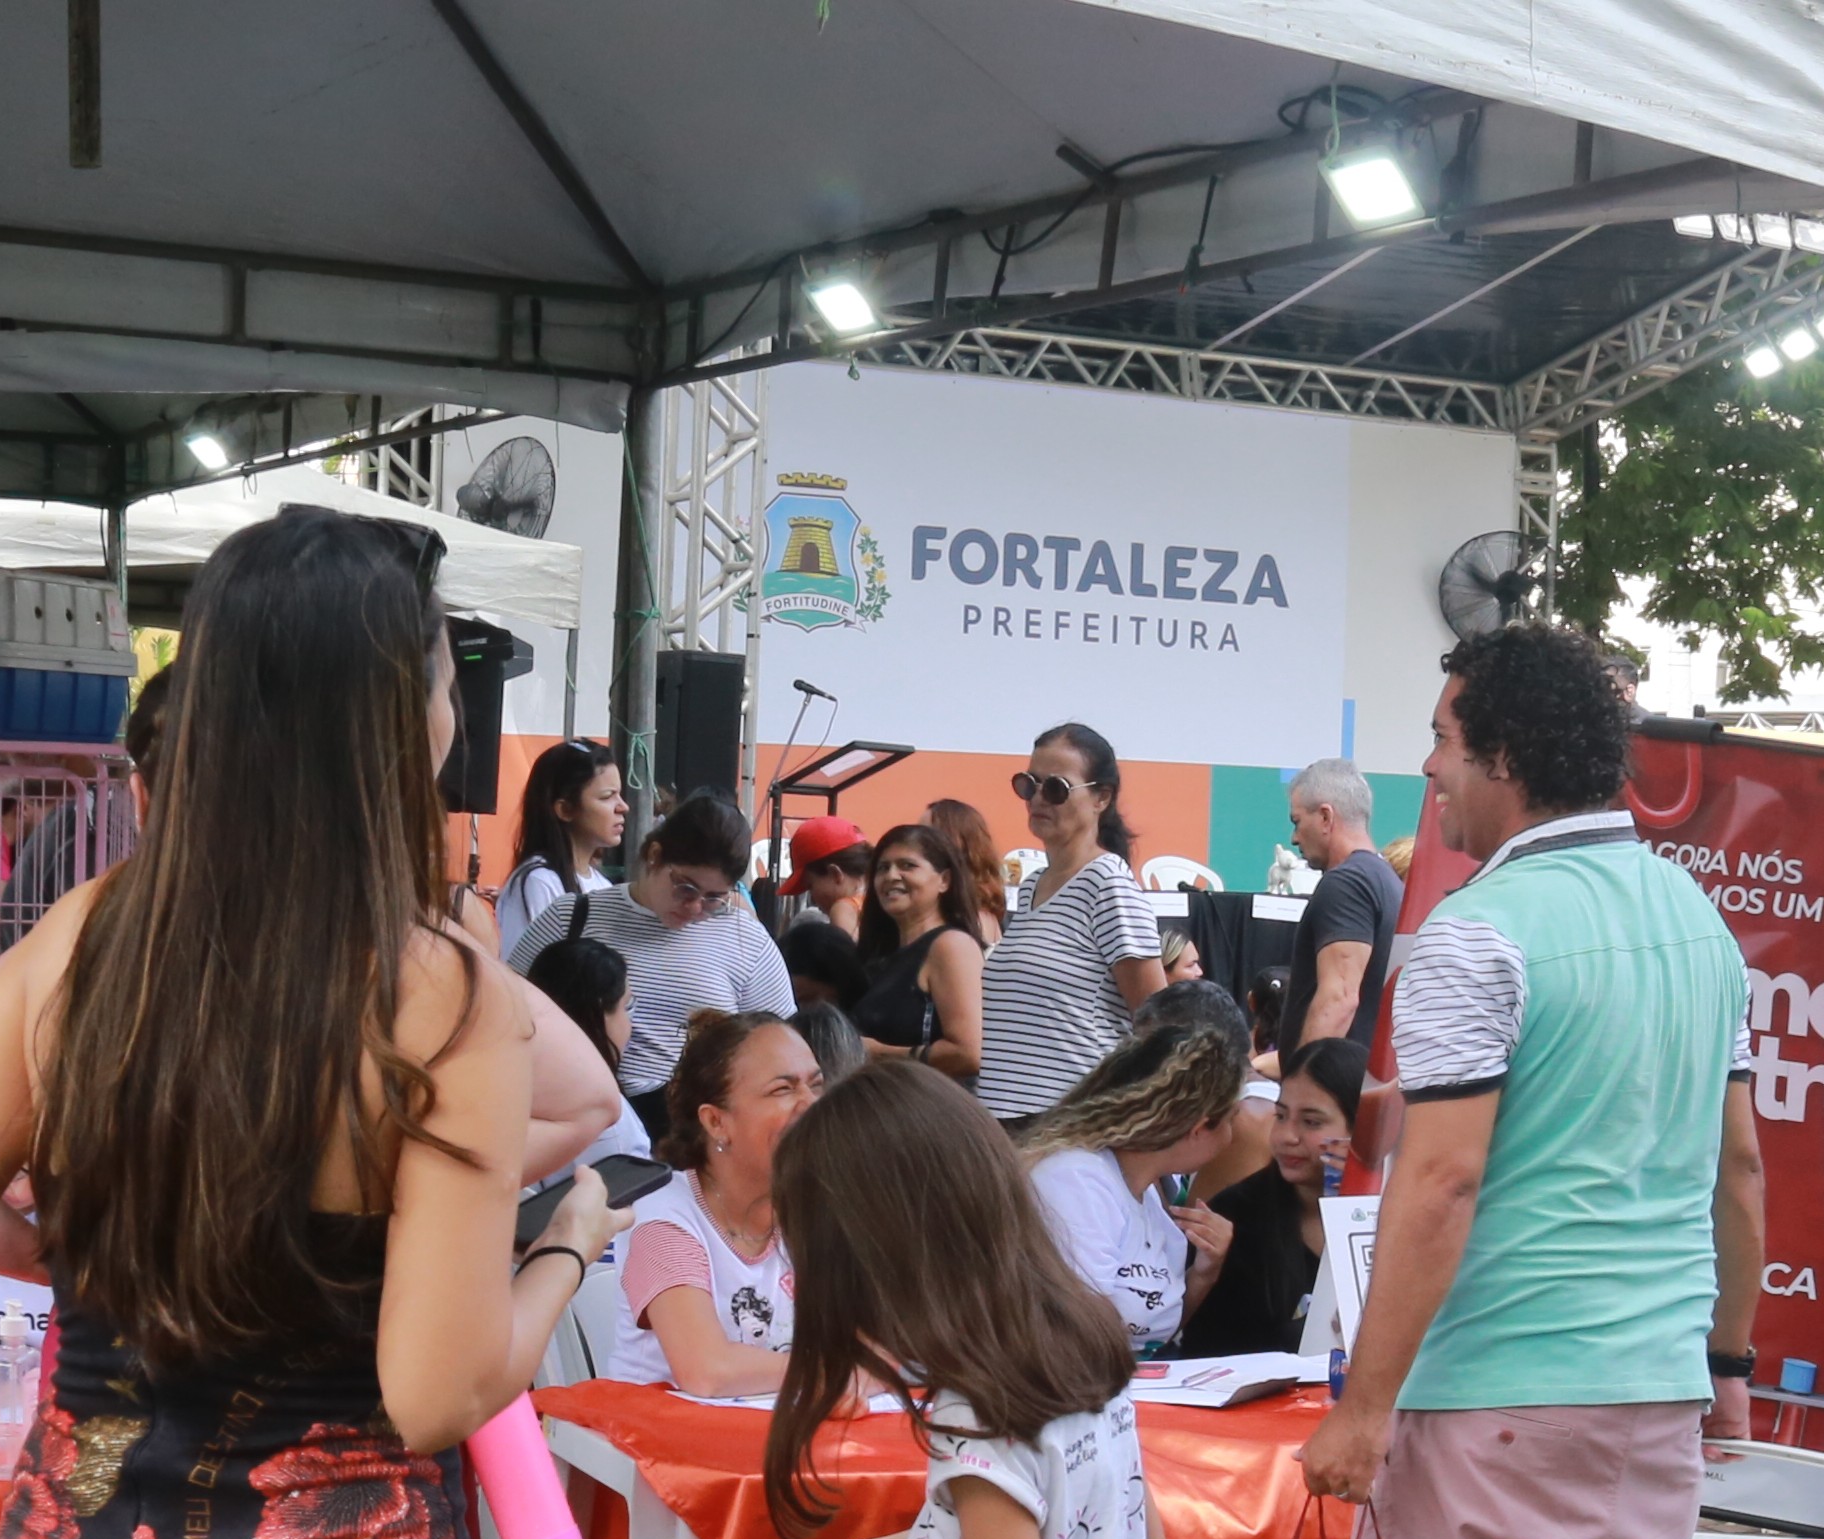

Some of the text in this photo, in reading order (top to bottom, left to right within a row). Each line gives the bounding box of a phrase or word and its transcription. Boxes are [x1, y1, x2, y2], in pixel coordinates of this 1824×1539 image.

[911, 525, 1289, 608] FORTALEZA
[765, 597, 849, 616] FORTITUDINE
[963, 604, 1241, 653] PREFEITURA
[1737, 850, 1803, 884] NÓS
[1772, 891, 1824, 922] UM
